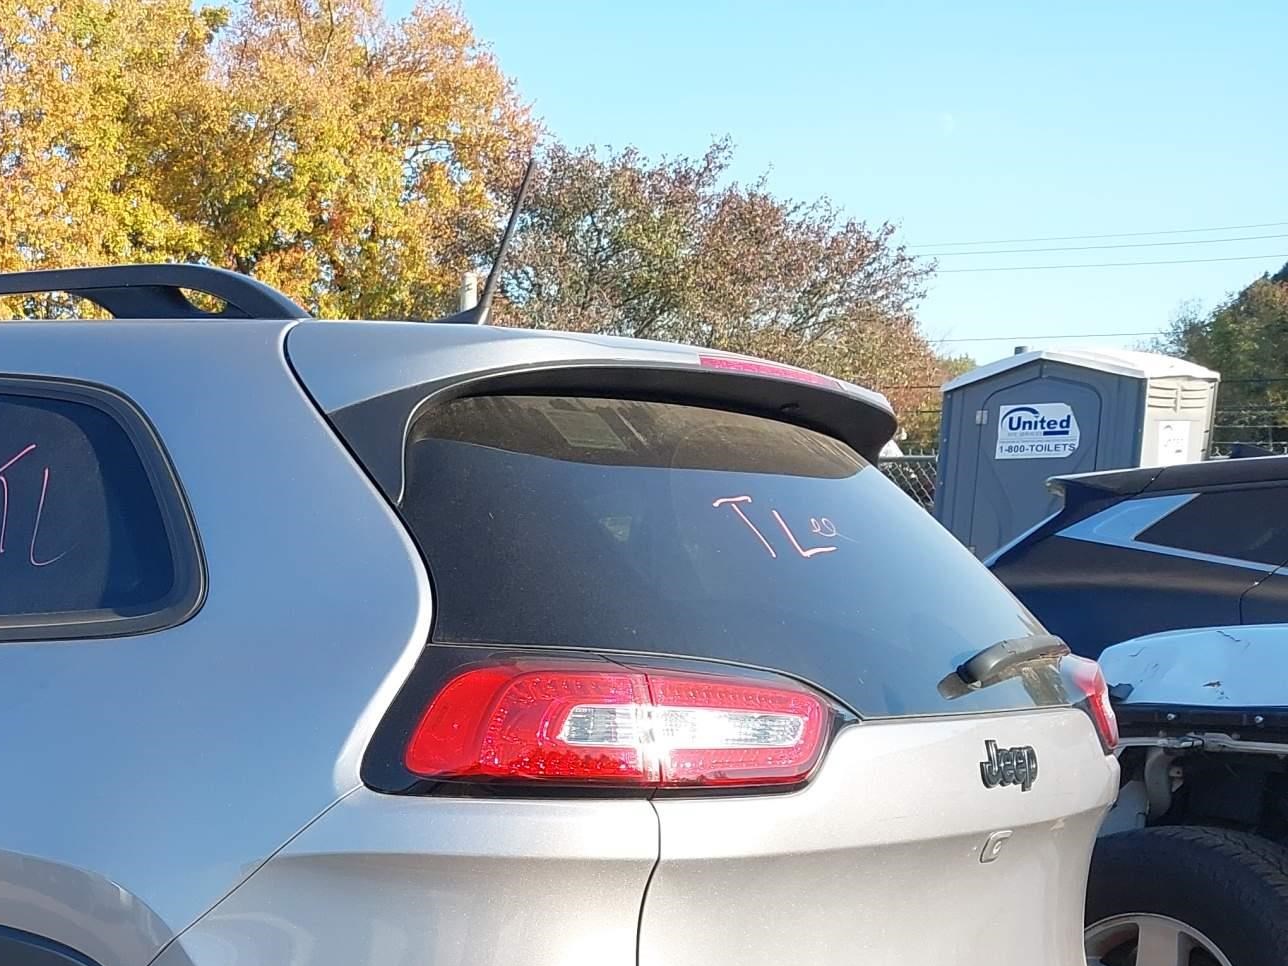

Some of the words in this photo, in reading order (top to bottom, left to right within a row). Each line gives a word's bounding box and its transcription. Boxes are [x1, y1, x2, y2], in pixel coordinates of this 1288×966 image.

[1008, 414, 1071, 431] United
[999, 443, 1077, 454] 1-800-TOILETS
[979, 739, 1038, 792] Jeep
